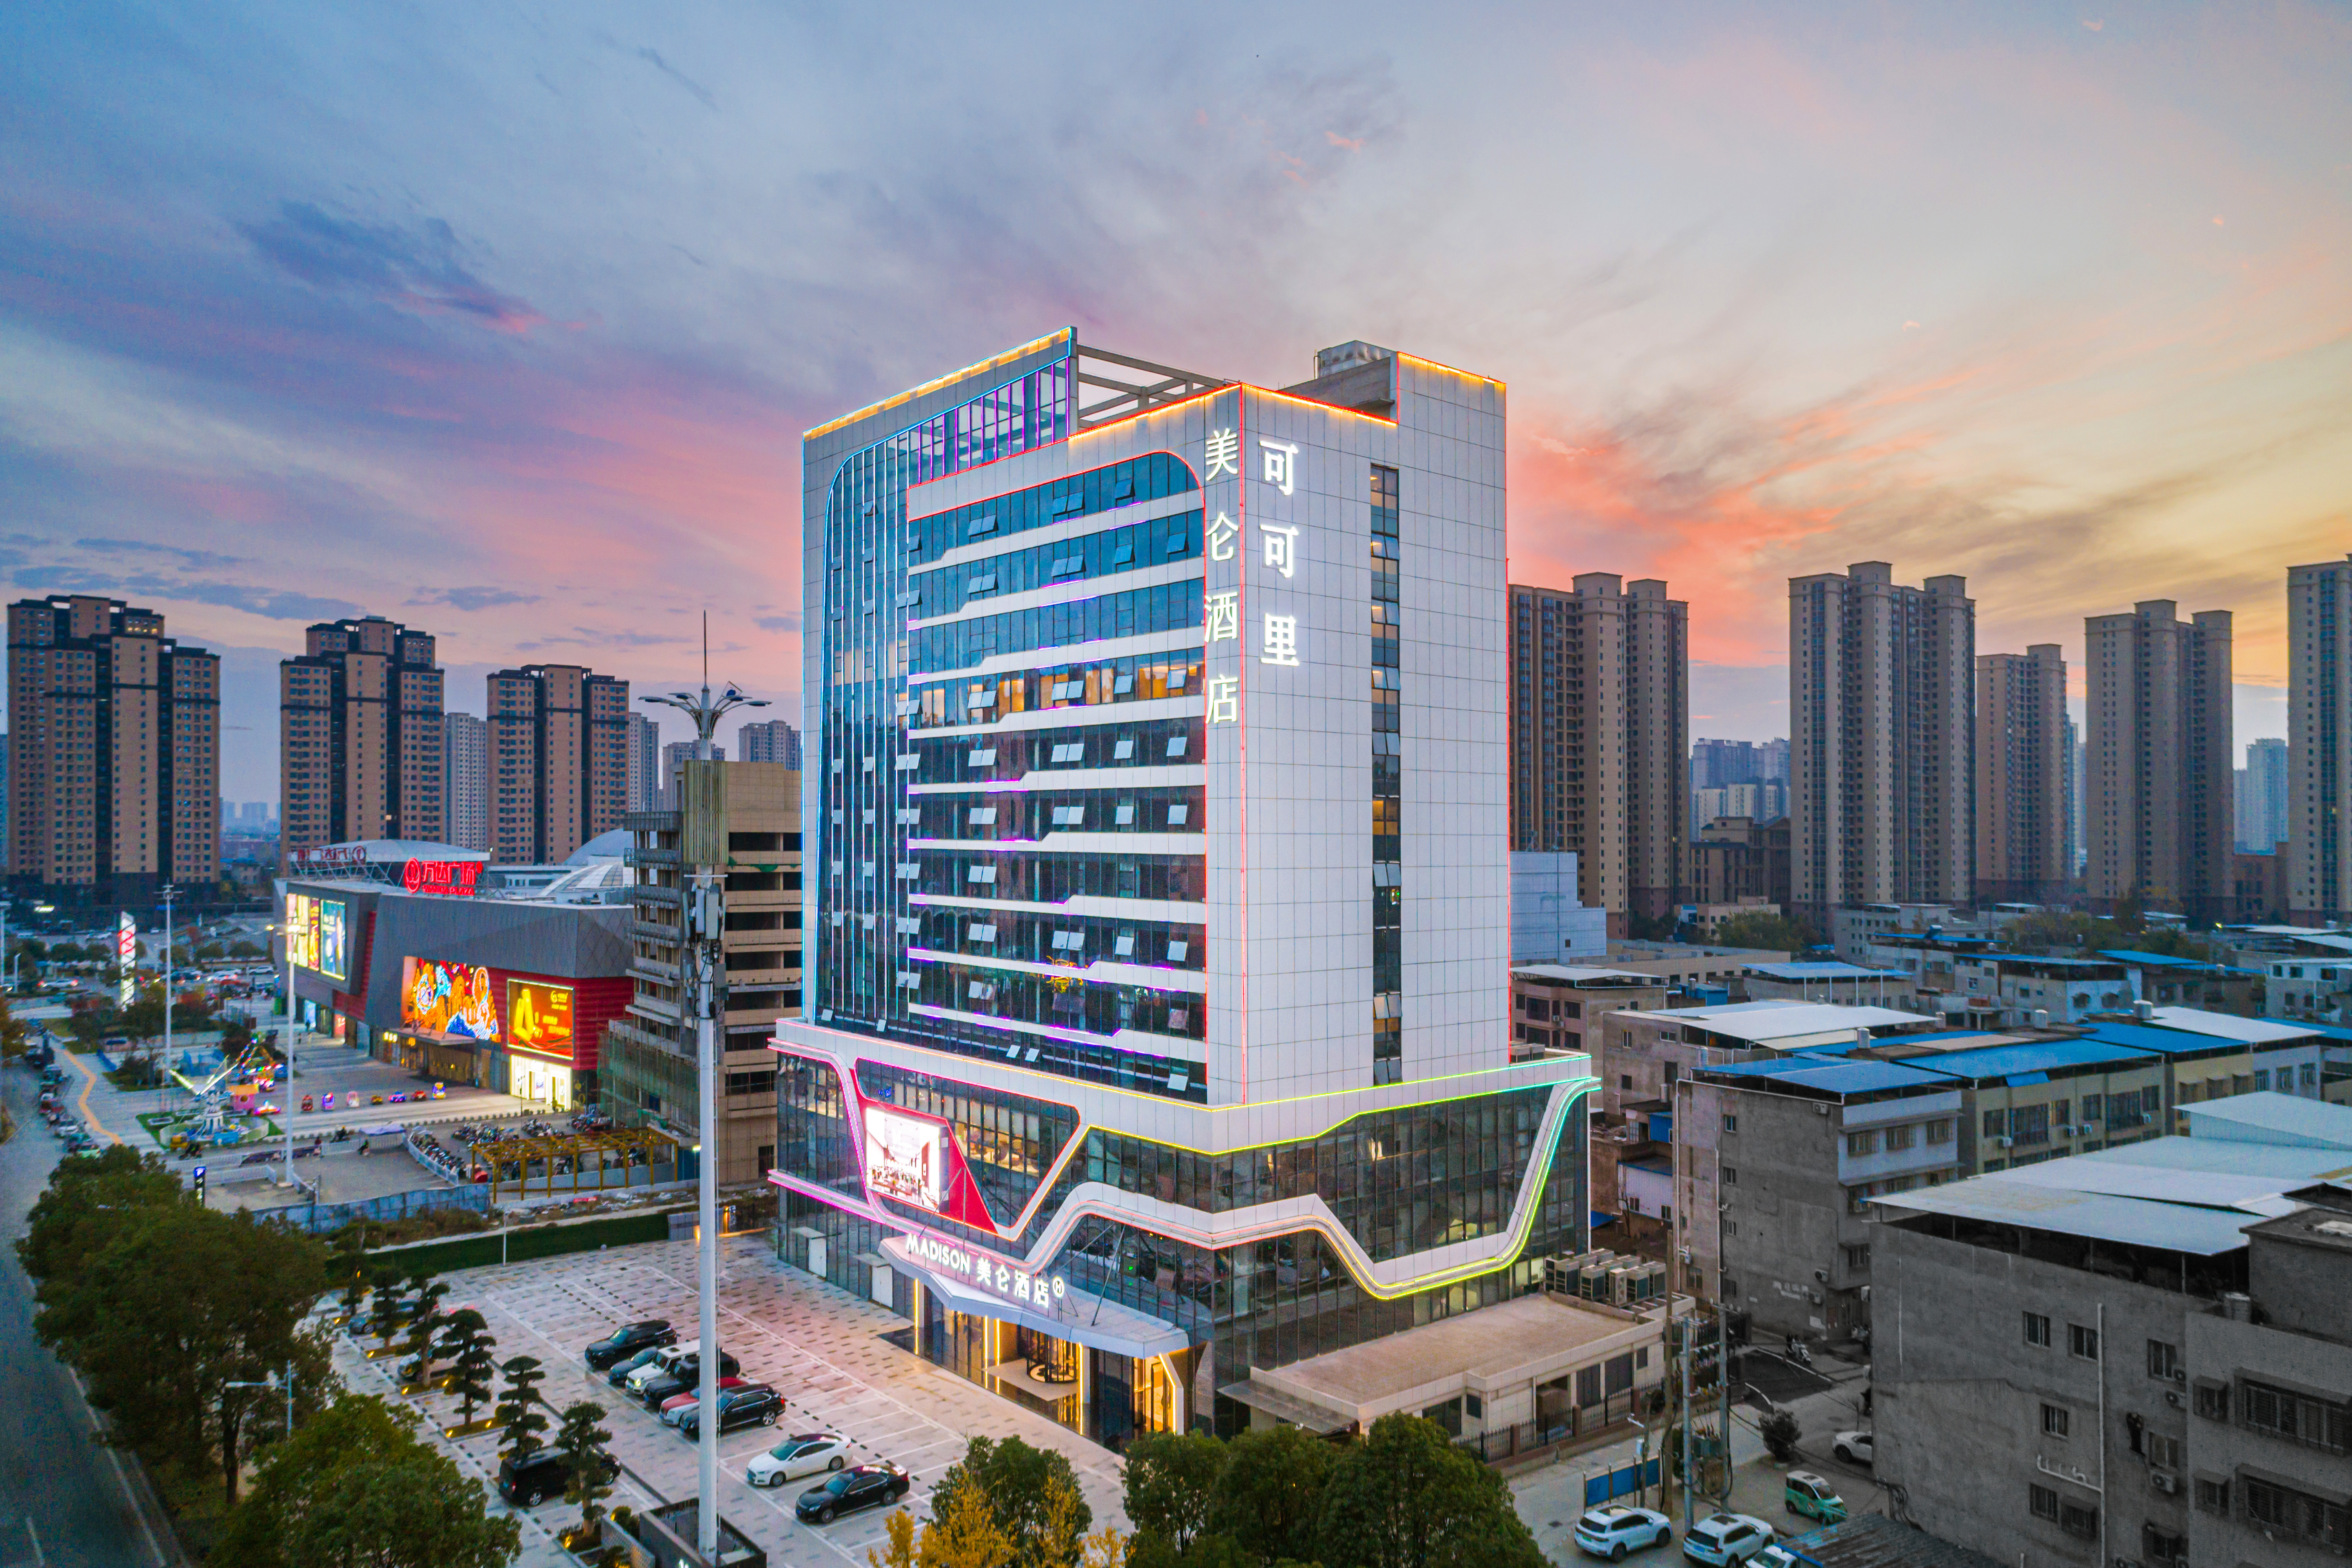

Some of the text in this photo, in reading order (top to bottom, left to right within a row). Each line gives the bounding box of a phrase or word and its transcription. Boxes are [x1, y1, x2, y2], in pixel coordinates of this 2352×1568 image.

[1205, 428, 1239, 724] 美仑酒店
[1259, 440, 1299, 666] 可可里
[422, 861, 475, 885] 万达广场
[423, 885, 474, 896] WANDA PLAZA
[906, 1232, 971, 1274] MADISON
[977, 1257, 1049, 1308] 美仑酒店
